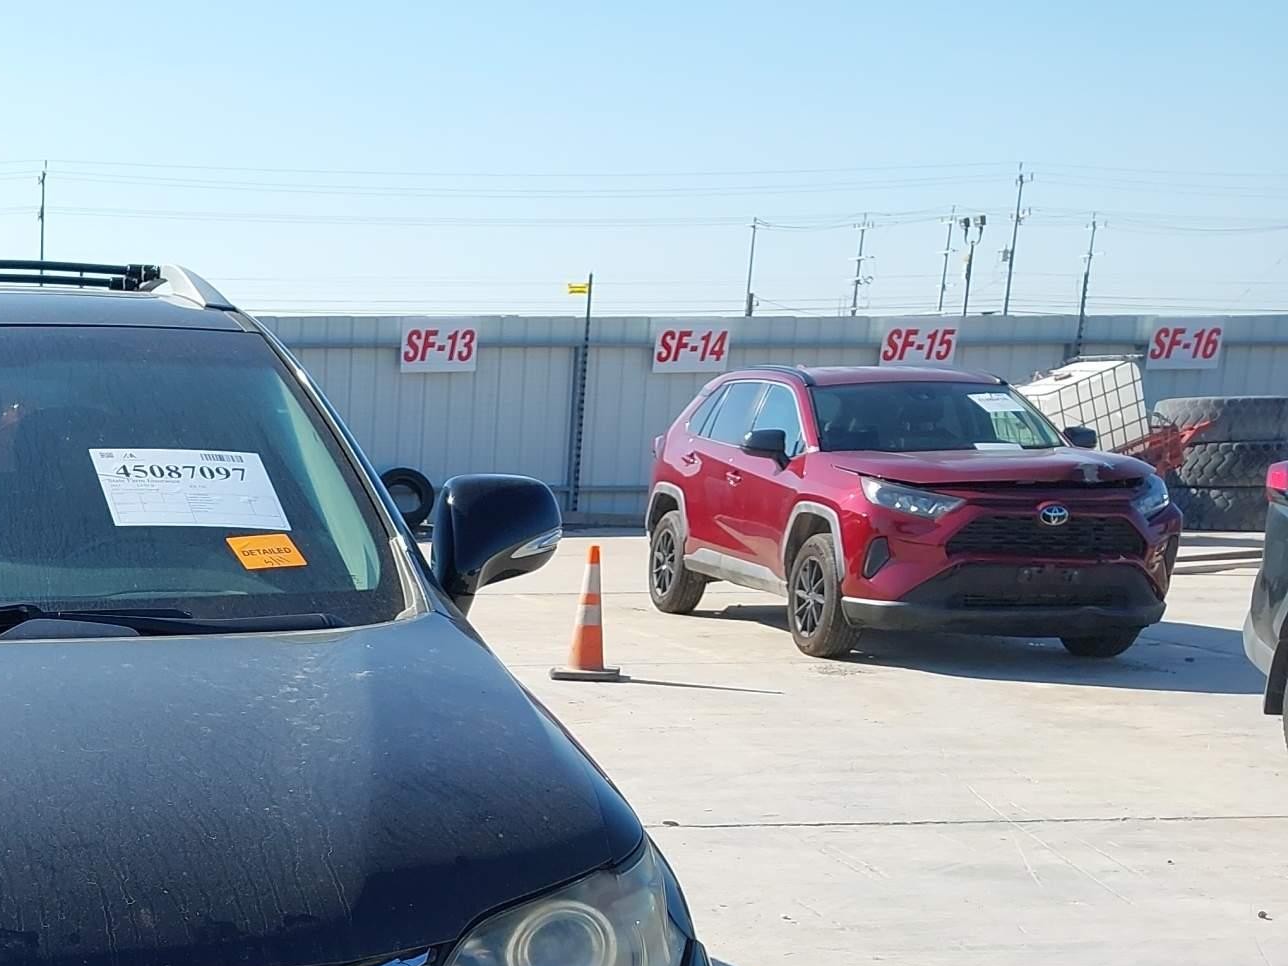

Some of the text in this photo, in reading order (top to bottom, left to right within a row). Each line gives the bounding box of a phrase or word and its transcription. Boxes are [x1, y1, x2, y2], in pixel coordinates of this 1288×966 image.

[403, 329, 475, 363] SF-13
[656, 330, 728, 363] SF-14
[882, 328, 955, 362] SF-15
[1150, 327, 1222, 360] SF-16
[116, 464, 246, 482] 45087097
[242, 546, 292, 557] DETAILED
